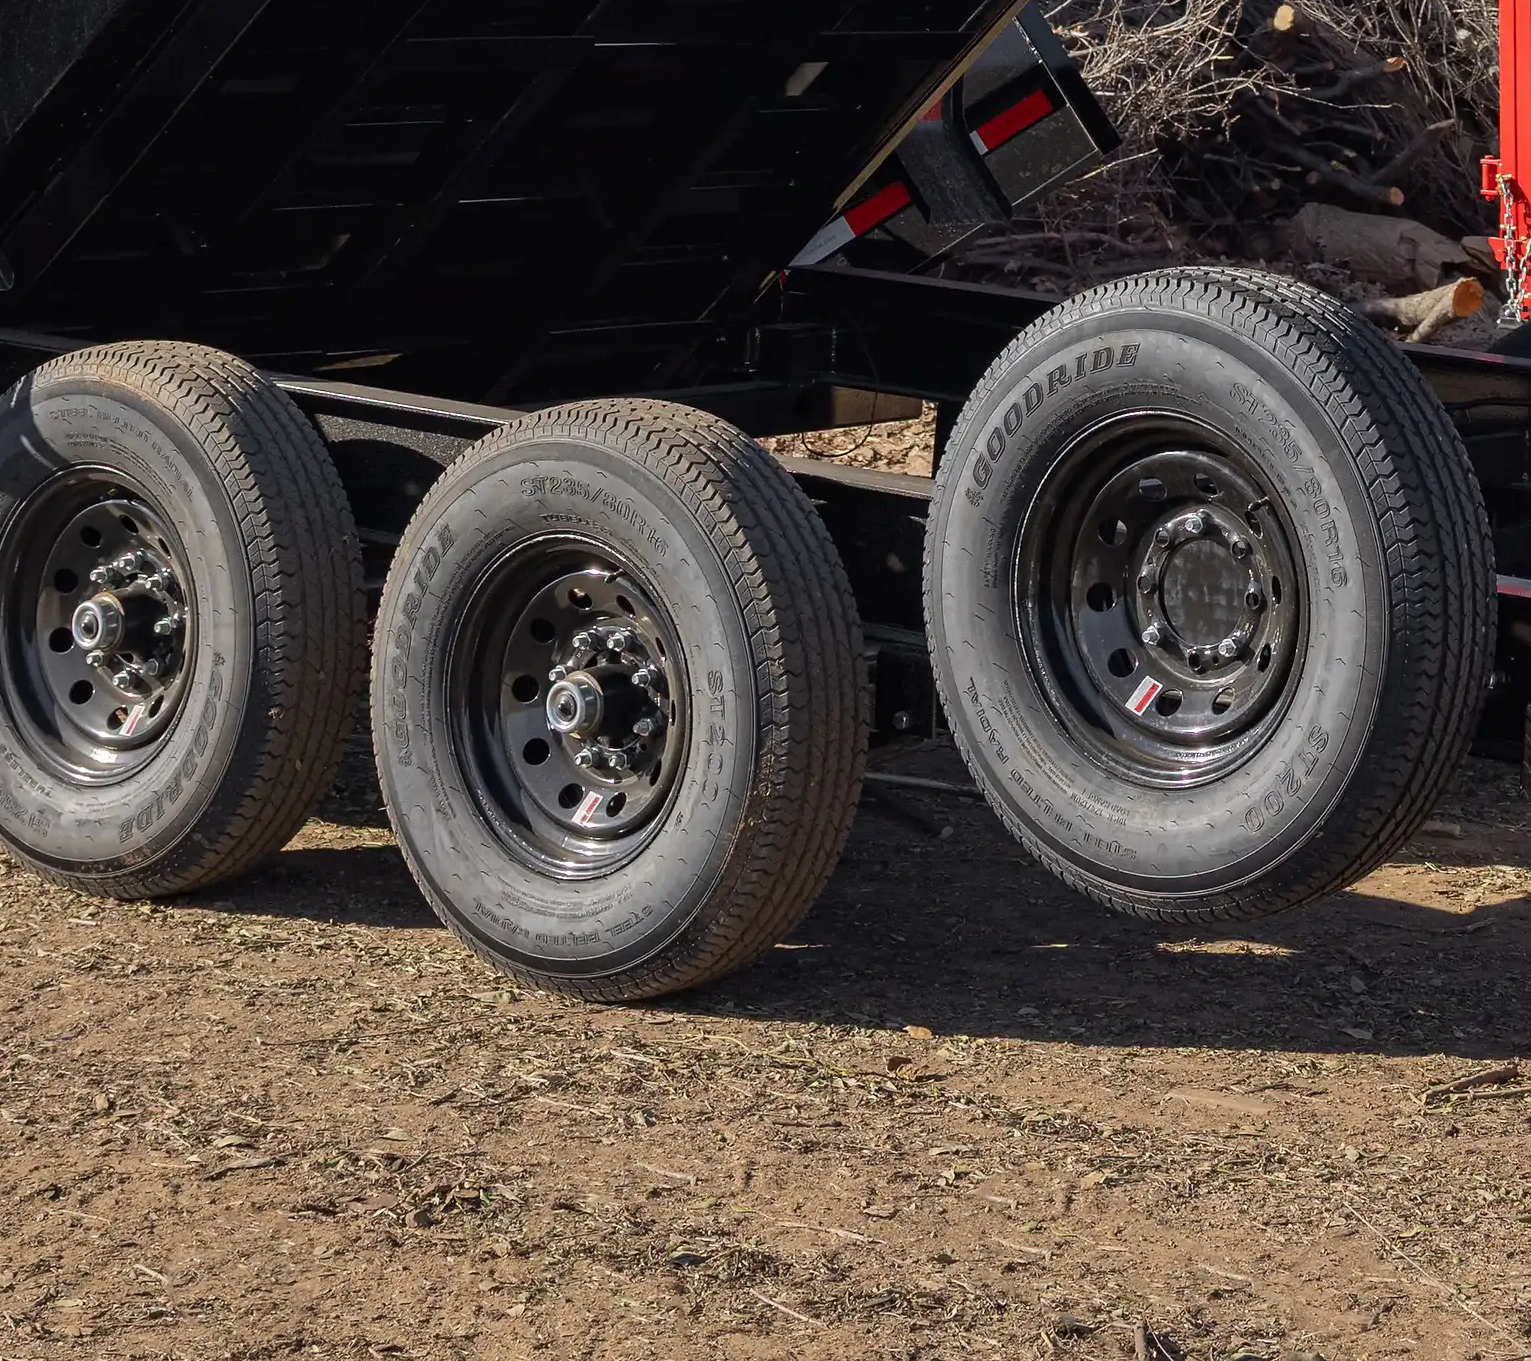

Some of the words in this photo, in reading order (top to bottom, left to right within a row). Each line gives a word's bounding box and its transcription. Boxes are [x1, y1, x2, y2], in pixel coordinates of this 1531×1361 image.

[972, 342, 1141, 490] GOODRIDE
[1230, 383, 1348, 588] ST235/80R16
[520, 476, 669, 558] ST235/80R16
[392, 523, 455, 748] GOODRIDE
[120, 669, 223, 843] GOODRIDE
[966, 677, 1009, 765] RADIAL
[1244, 724, 1329, 832] ST200
